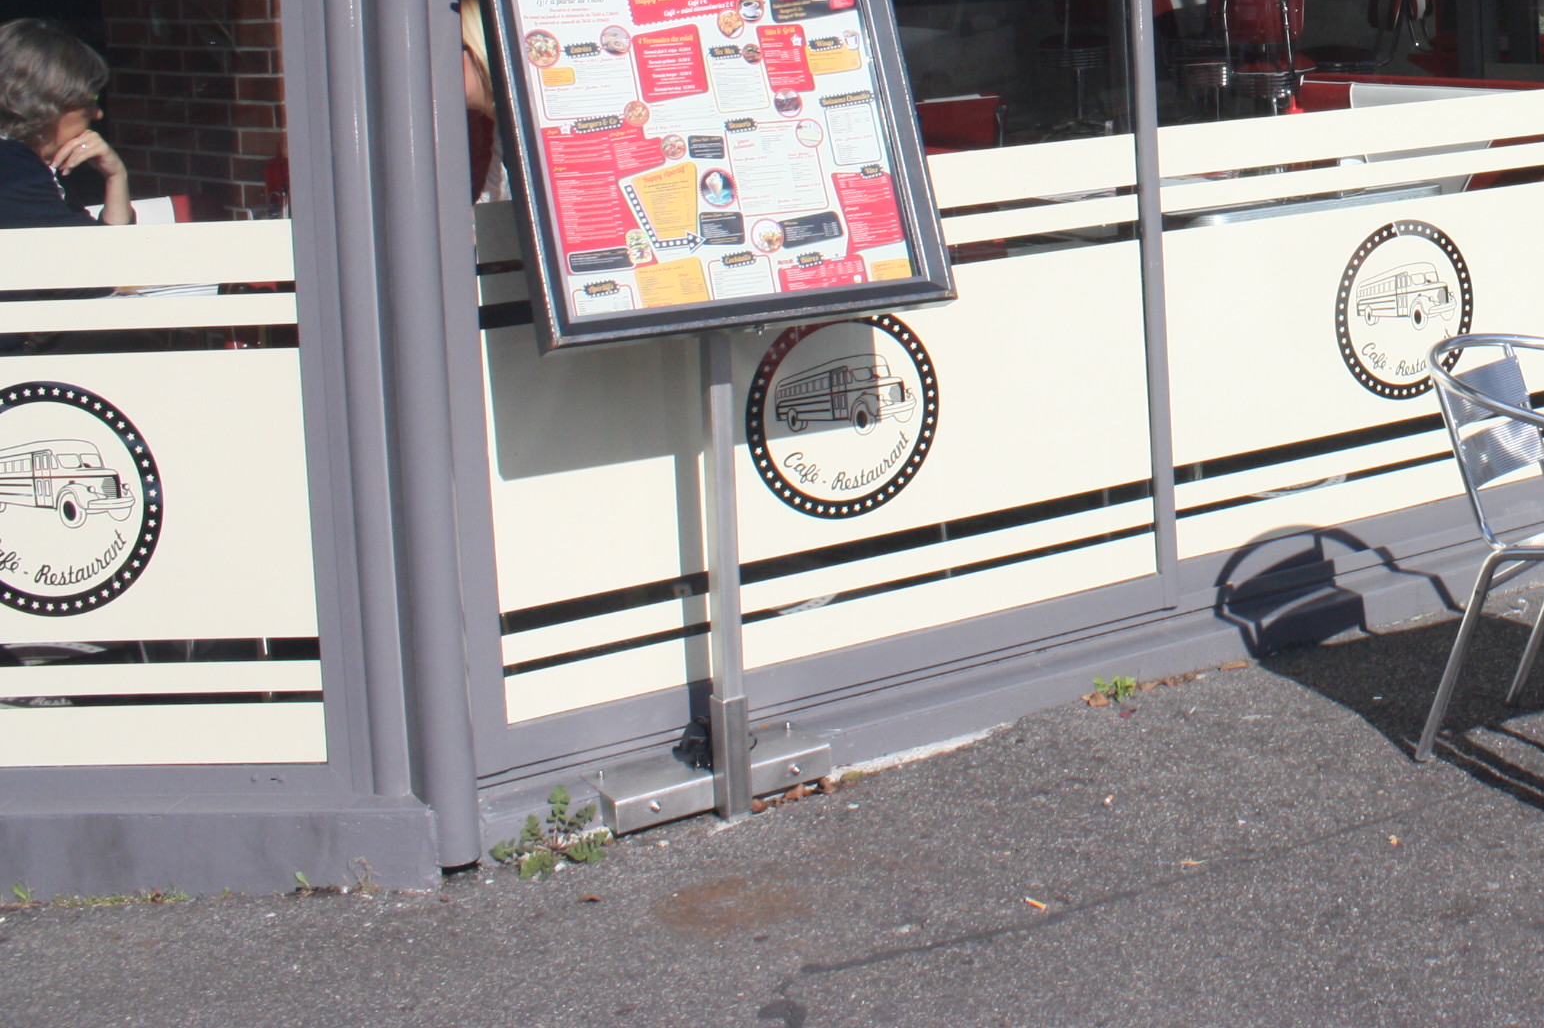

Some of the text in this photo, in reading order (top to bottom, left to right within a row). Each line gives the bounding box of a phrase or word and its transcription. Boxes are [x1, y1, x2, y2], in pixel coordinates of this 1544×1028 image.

[1361, 342, 1387, 369] Café
[783, 430, 910, 491] Café Restaurant
[34, 529, 127, 586] Restaurant
